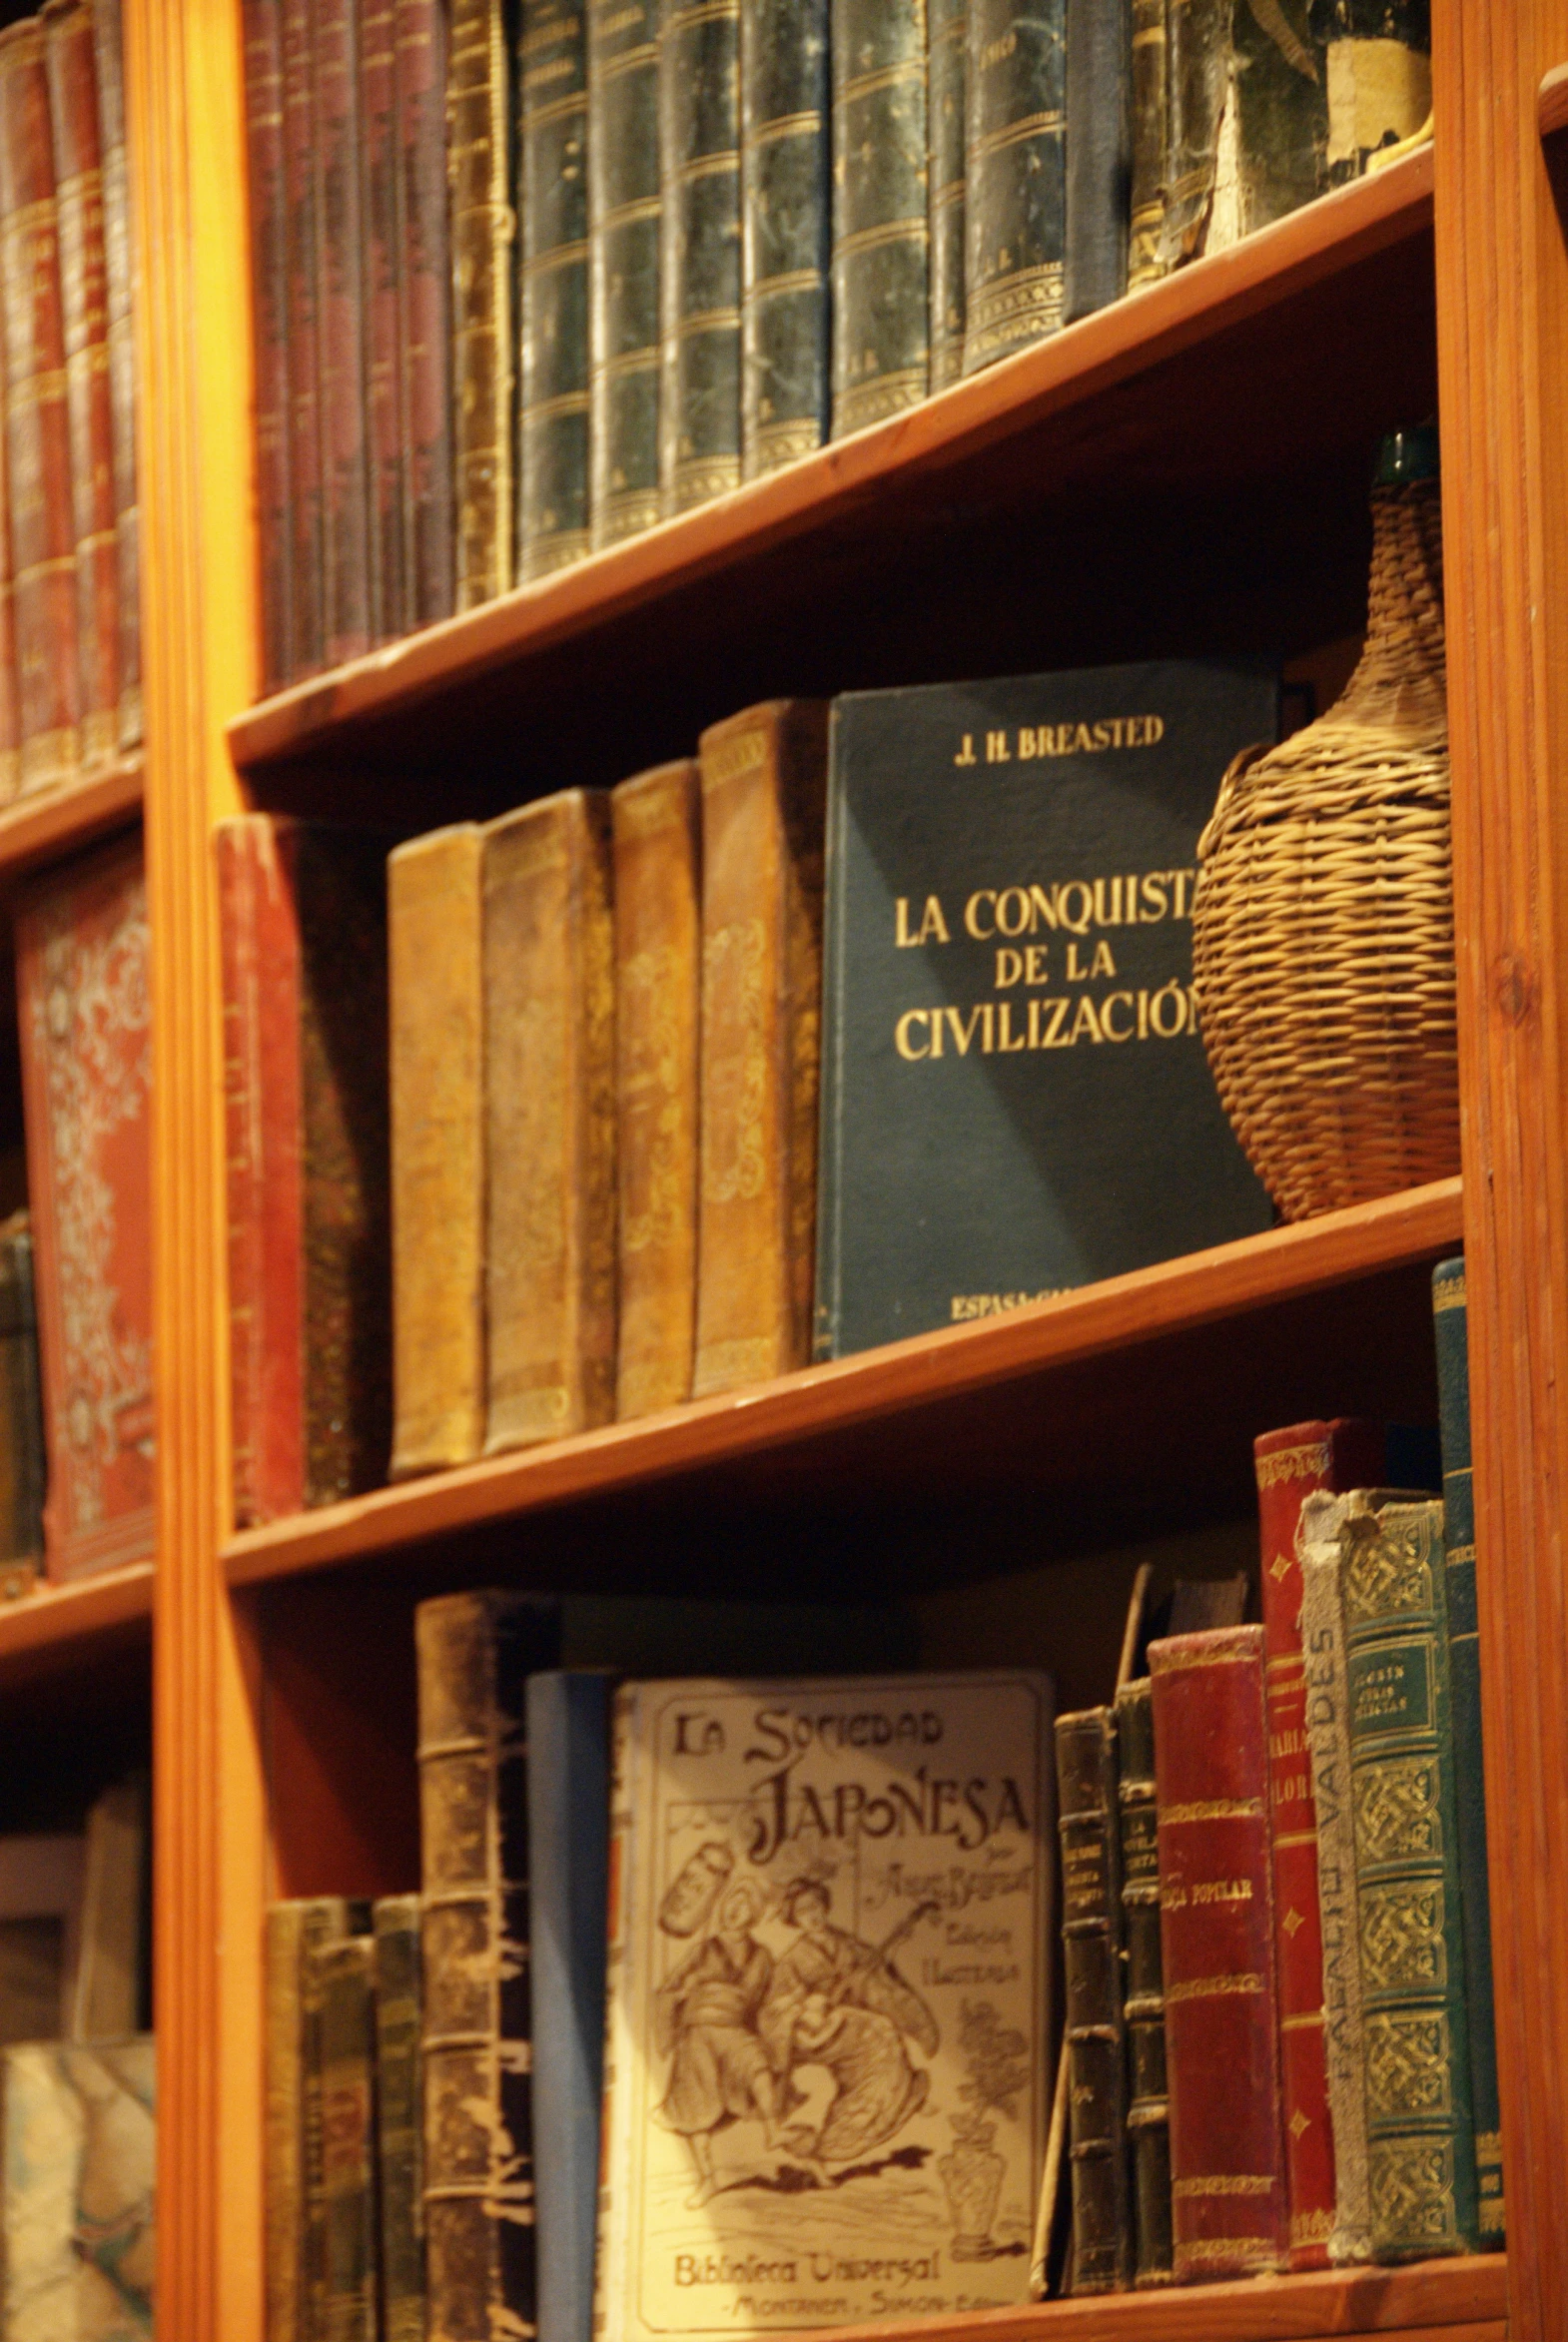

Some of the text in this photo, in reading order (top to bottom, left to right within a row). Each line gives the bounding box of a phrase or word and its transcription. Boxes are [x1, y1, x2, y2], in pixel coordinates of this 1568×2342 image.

[1018, 715, 1166, 762] BREASTED
[895, 894, 951, 948] LA
[995, 940, 1117, 990] DE LA
[672, 1708, 945, 1764] LA SOCIEDAD
[1308, 1627, 1339, 1829] VALDES
[747, 1766, 1031, 1866] JAPONESA
[674, 2248, 941, 2289] Biblioteca Universal
